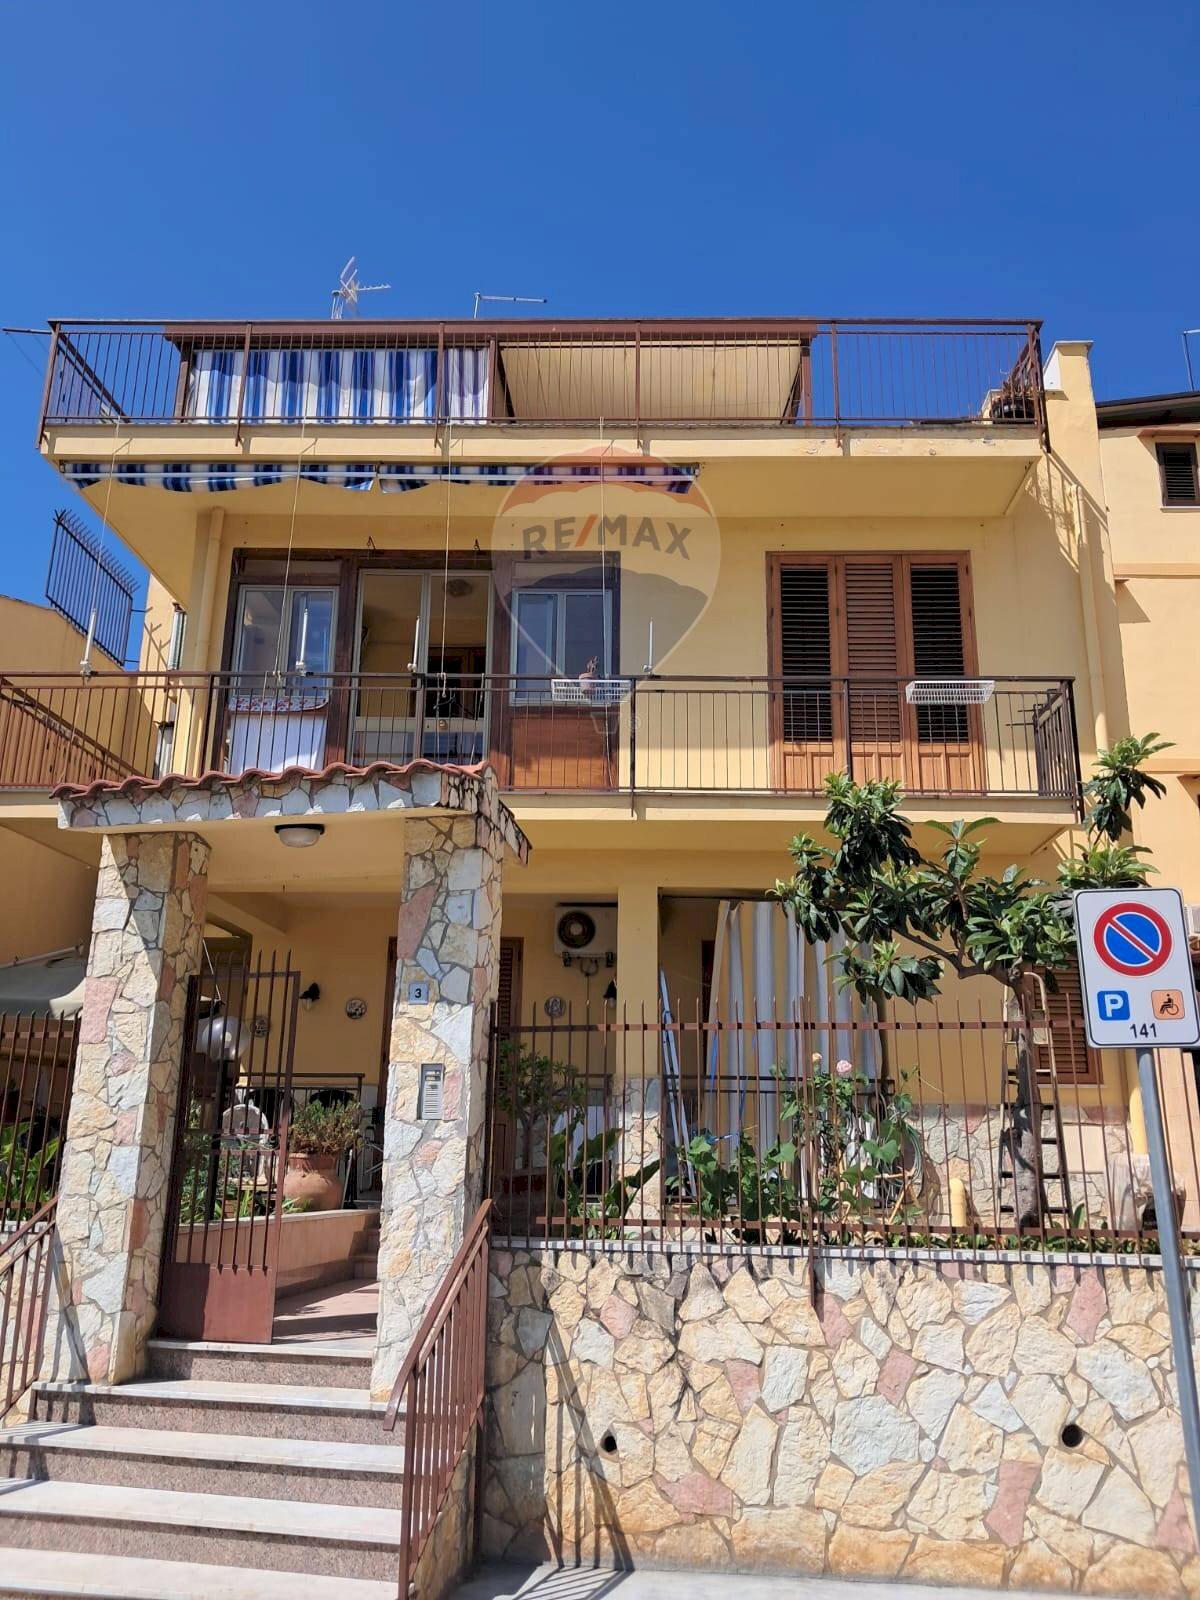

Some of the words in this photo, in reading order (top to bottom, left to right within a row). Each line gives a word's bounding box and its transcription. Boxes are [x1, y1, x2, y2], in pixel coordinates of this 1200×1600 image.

[414, 988, 422, 999] 3
[1104, 994, 1124, 1017] P
[1130, 1023, 1157, 1038] 141
